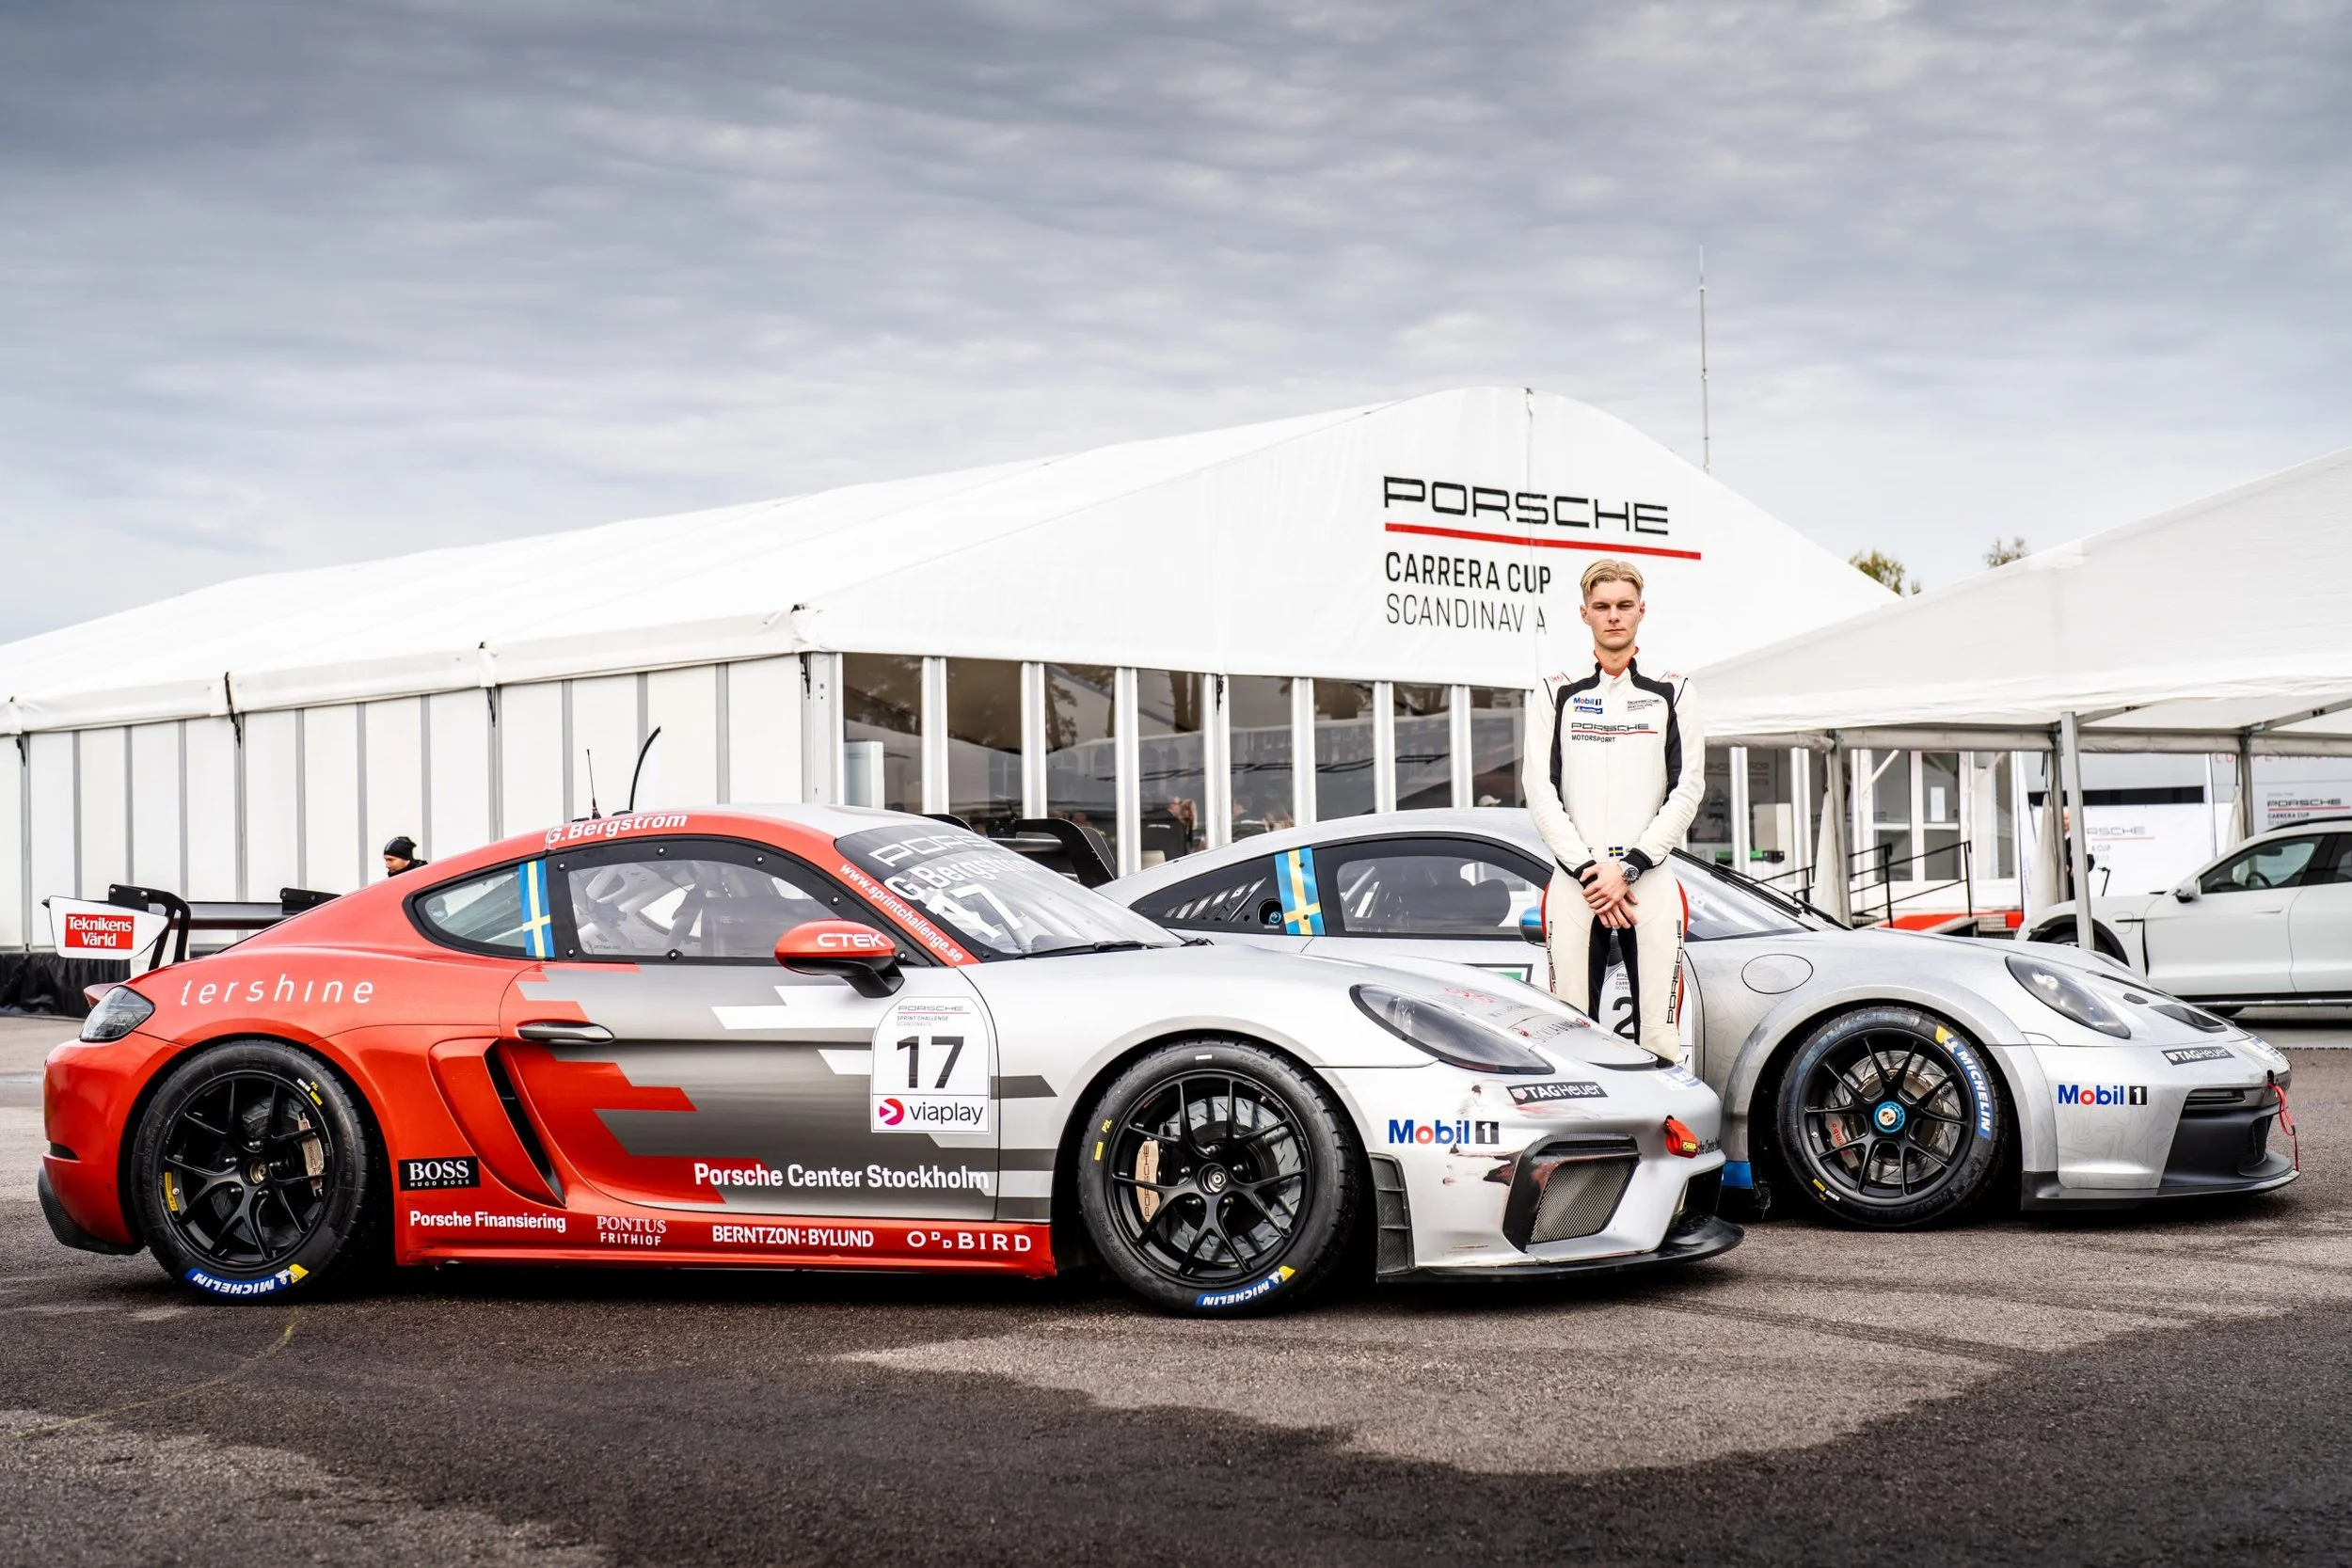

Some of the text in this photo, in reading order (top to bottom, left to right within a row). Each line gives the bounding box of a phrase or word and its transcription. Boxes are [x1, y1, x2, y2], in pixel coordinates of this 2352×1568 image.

[1383, 475, 1669, 535] PORSCHE
[1385, 550, 1551, 594] CARRERA CUP
[1386, 593, 1548, 635] SCANDINAVA
[1571, 722, 1649, 732] PORSCHE
[2267, 798, 2342, 807] PORSCHE
[68, 915, 133, 932] Teknikens
[840, 863, 963, 963] www.sprintchallenge.se
[925, 883, 1024, 939] 17
[81, 931, 118, 948] Värld
[817, 932, 886, 948] CTEK
[1666, 919, 1684, 1024] PORSCHE
[181, 973, 373, 1006] tershine
[897, 1036, 964, 1089] 17
[1958, 1050, 1991, 1132] MICHELIN
[2058, 1085, 2145, 1105] Mobil 1
[909, 1101, 984, 1126] viaplay
[1389, 1119, 1495, 1145] Mobil 1
[408, 1160, 469, 1181] BOSS
[694, 1163, 990, 1189] Porsche Center Stockholm
[409, 1210, 566, 1233] Porsche Finansiering
[596, 1215, 667, 1234] PONTUS
[600, 1232, 661, 1246] FRITHIOF
[712, 1225, 874, 1248] BERNTZON:BYLUND
[193, 1272, 275, 1295] MICHELIN
[1202, 1280, 1270, 1306] MICHELIN
